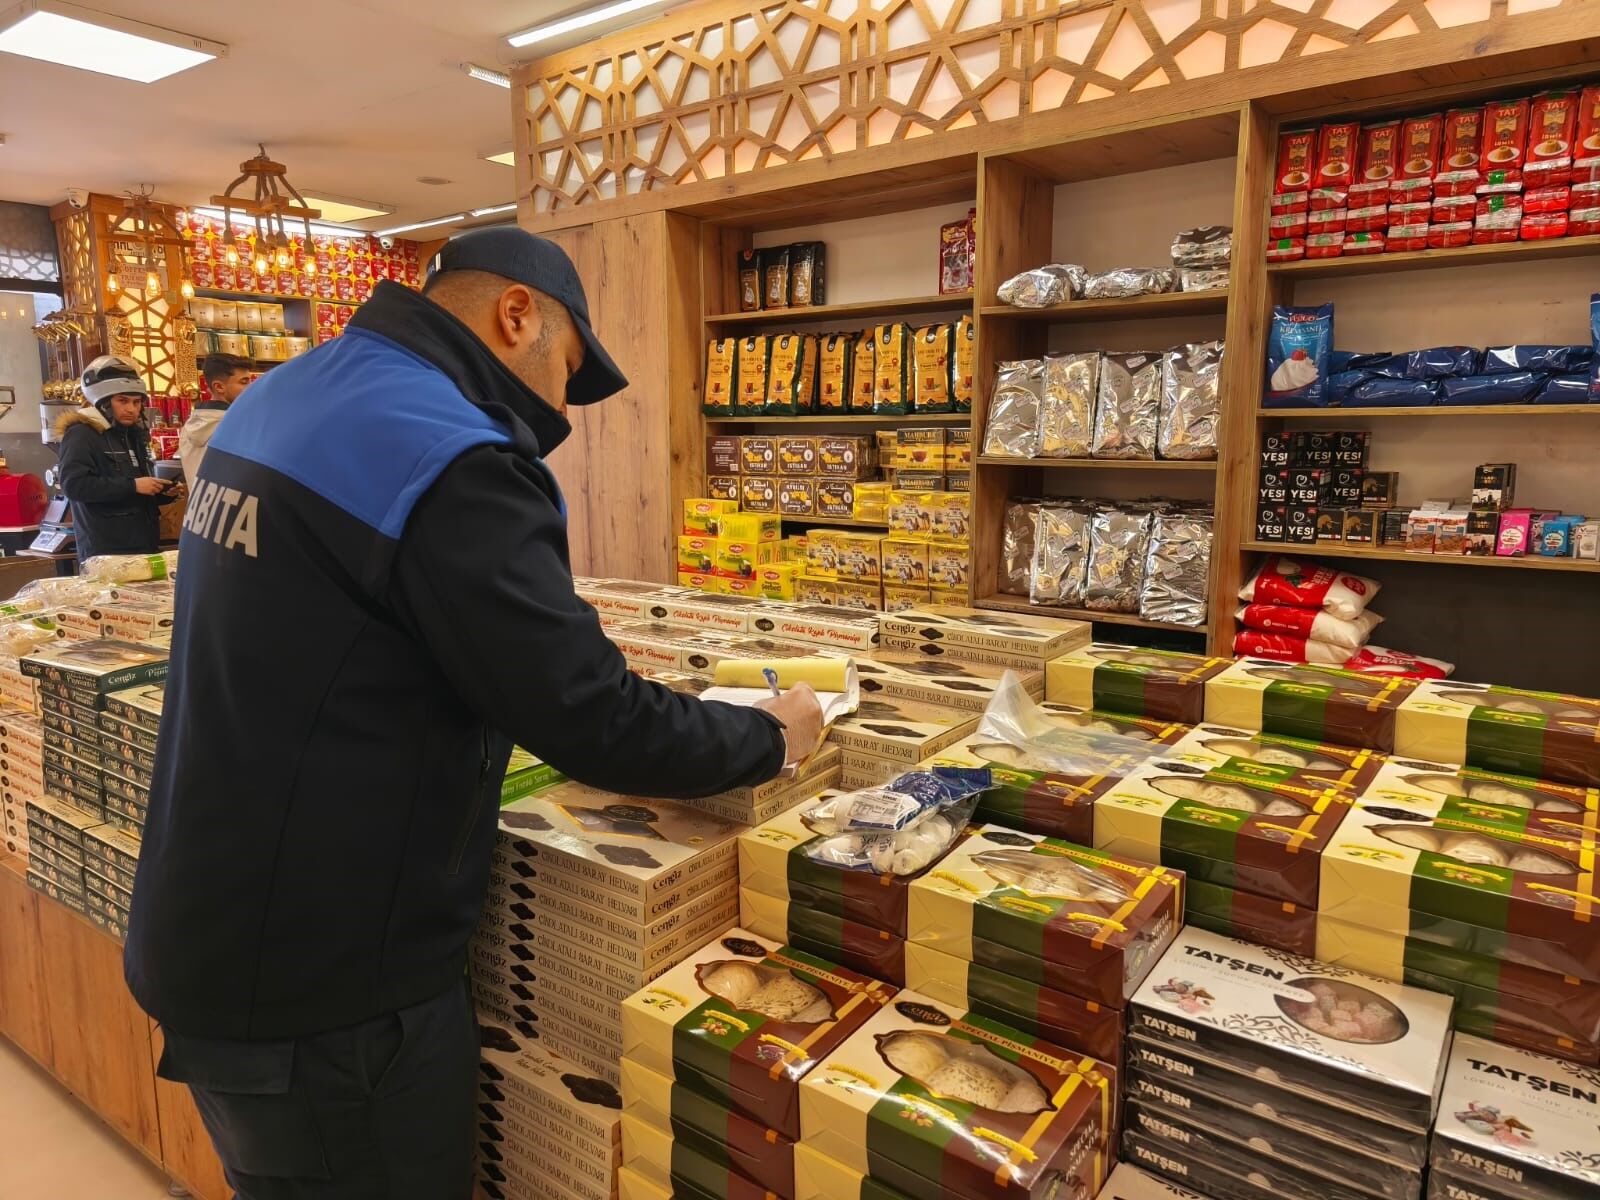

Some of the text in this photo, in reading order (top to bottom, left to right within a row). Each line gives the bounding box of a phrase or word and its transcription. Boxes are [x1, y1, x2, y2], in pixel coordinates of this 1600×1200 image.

[1547, 102, 1566, 110] TAT
[1499, 108, 1516, 116] TAT
[1458, 116, 1476, 124] TAT
[1414, 122, 1431, 130] TAT
[1375, 130, 1390, 138] TAT
[1262, 453, 1288, 461] YES!
[1306, 452, 1331, 460] YES!
[1336, 452, 1362, 460] YES!
[1260, 490, 1286, 498] YES!
[1291, 490, 1317, 498] YES!
[1334, 488, 1360, 496] YES!
[1258, 525, 1282, 534] YES!
[1288, 527, 1314, 535] YES!
[885, 622, 916, 635] Cengiz
[652, 870, 682, 890] Cengiz
[652, 893, 681, 914] Cengiz
[651, 915, 680, 936] Cengiz
[1184, 945, 1284, 981] TATŞEN
[960, 1023, 999, 1043] SPECIAL
[1142, 1014, 1197, 1042] TATŞEN
[1140, 1050, 1195, 1077] TATŞEN
[1466, 1058, 1598, 1105] TATŞEN
[1138, 1080, 1192, 1109] TATŞEN
[1138, 1113, 1190, 1144] TATŞEN
[1136, 1146, 1188, 1176] TATŞEN
[1451, 1149, 1523, 1184] TATŞEN
